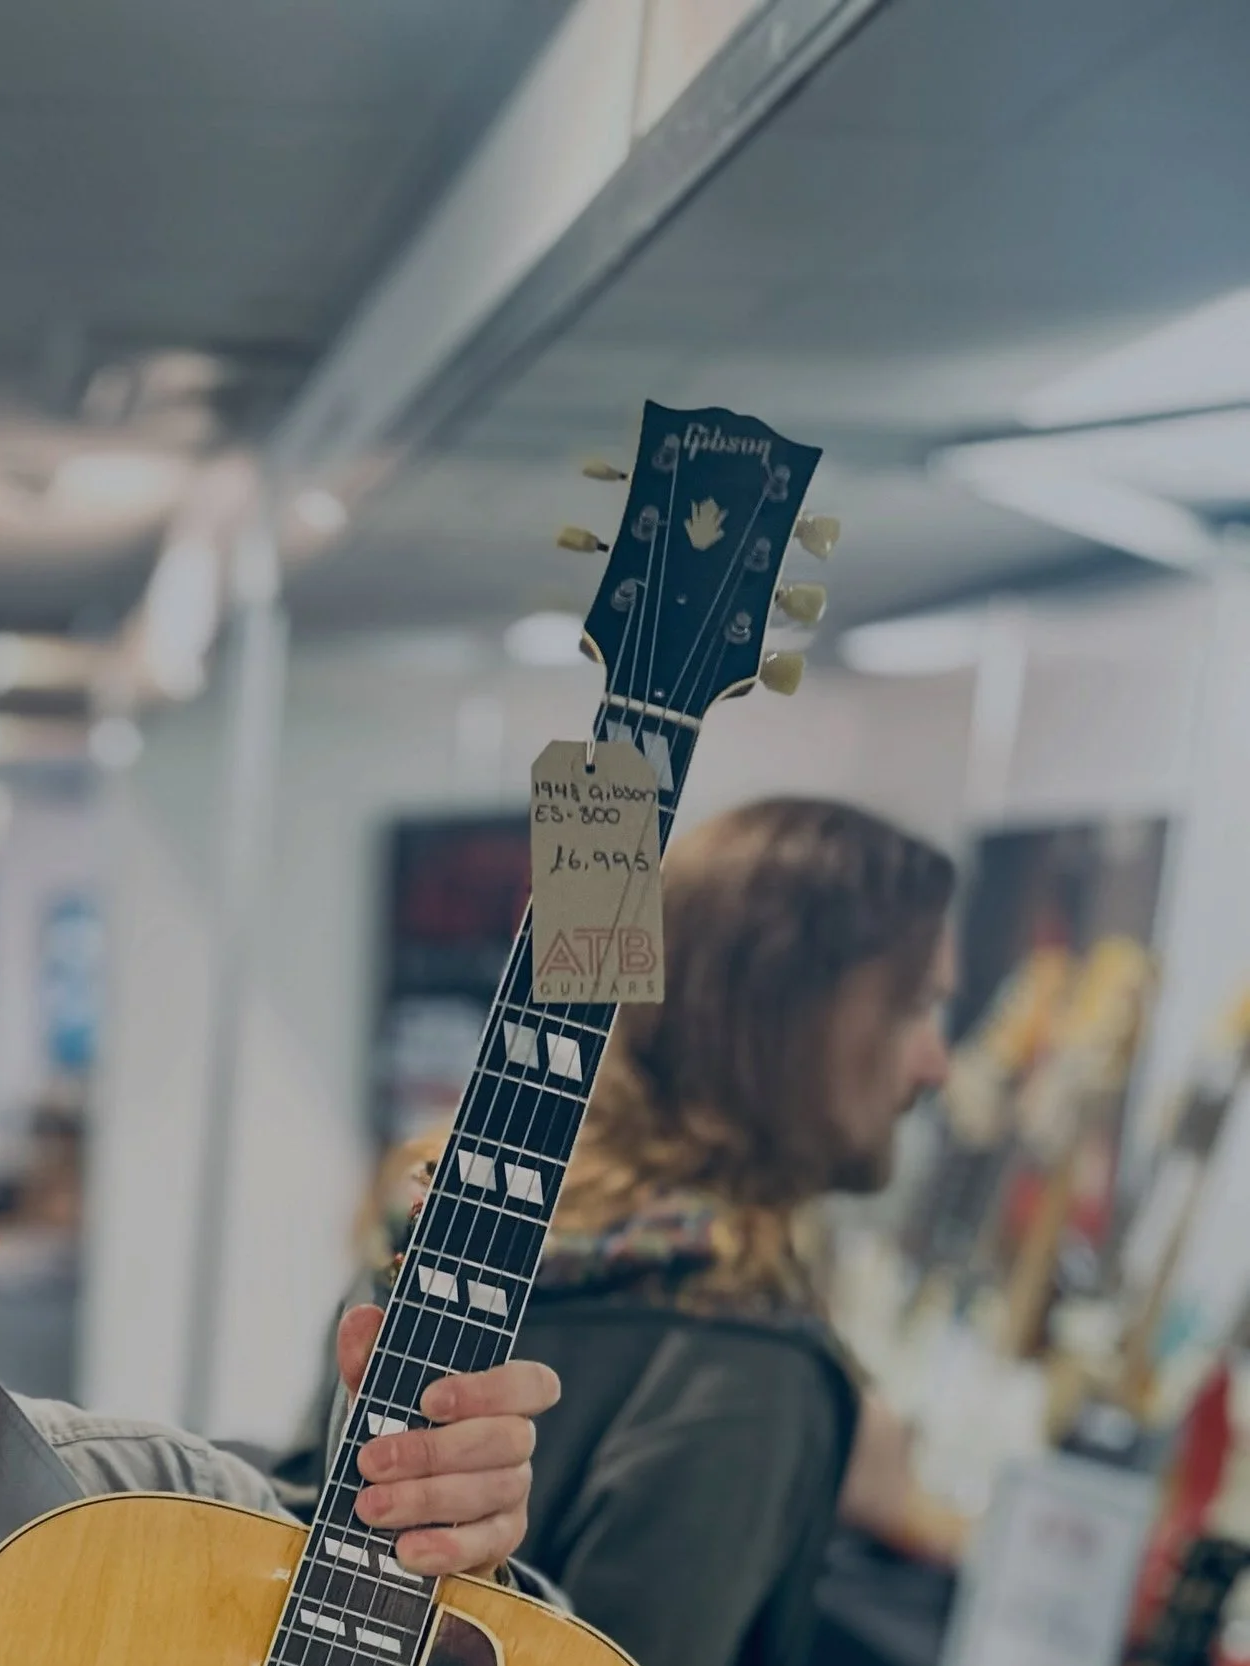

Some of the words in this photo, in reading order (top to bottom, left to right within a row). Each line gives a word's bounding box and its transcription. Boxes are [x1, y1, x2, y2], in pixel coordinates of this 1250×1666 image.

[683, 422, 772, 467] Gibson
[589, 784, 656, 802] Gibson
[536, 928, 657, 976] ATB
